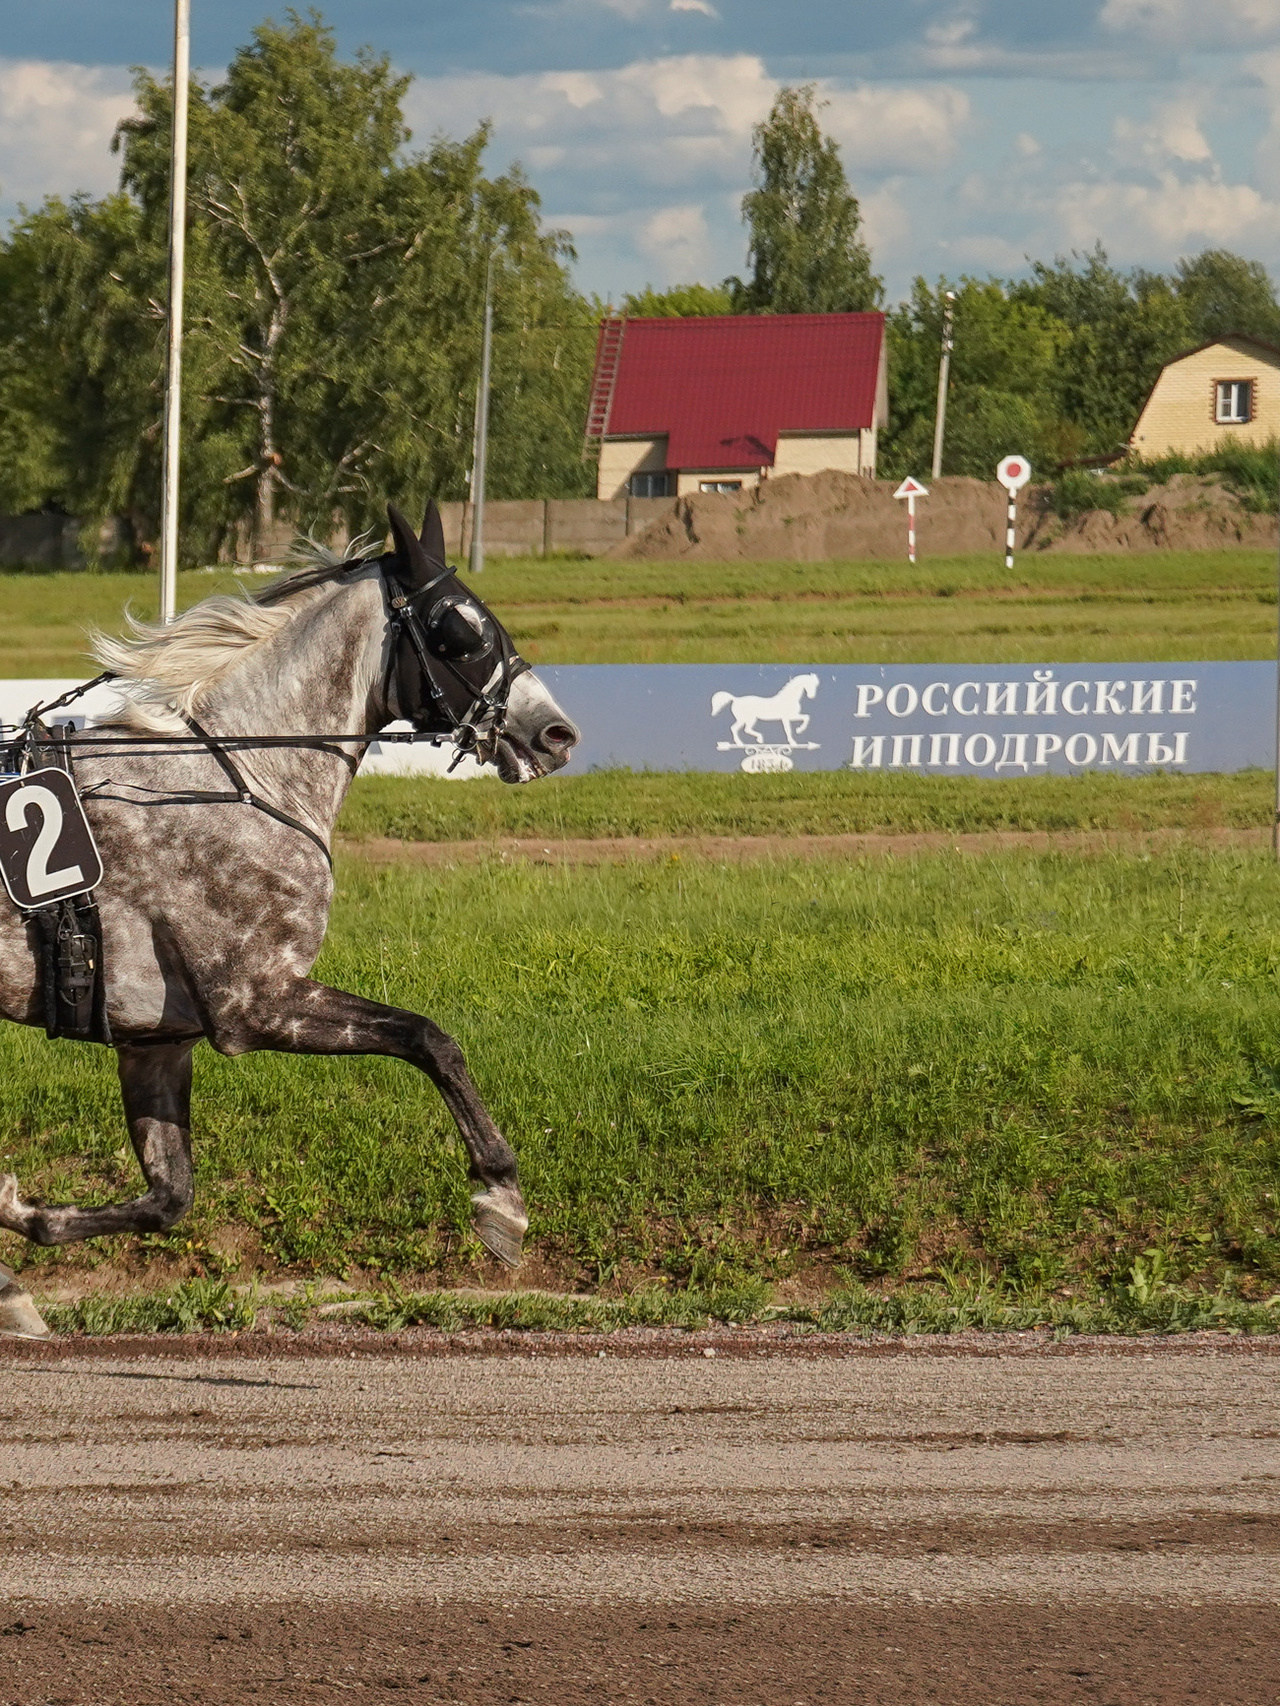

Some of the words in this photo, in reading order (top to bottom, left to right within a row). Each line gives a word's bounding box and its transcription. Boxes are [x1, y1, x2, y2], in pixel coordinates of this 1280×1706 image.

[854, 670, 1197, 717] РОССИЙСКИЕ
[850, 732, 1189, 773] ИППОДРОМЫ
[5, 785, 84, 897] 2
